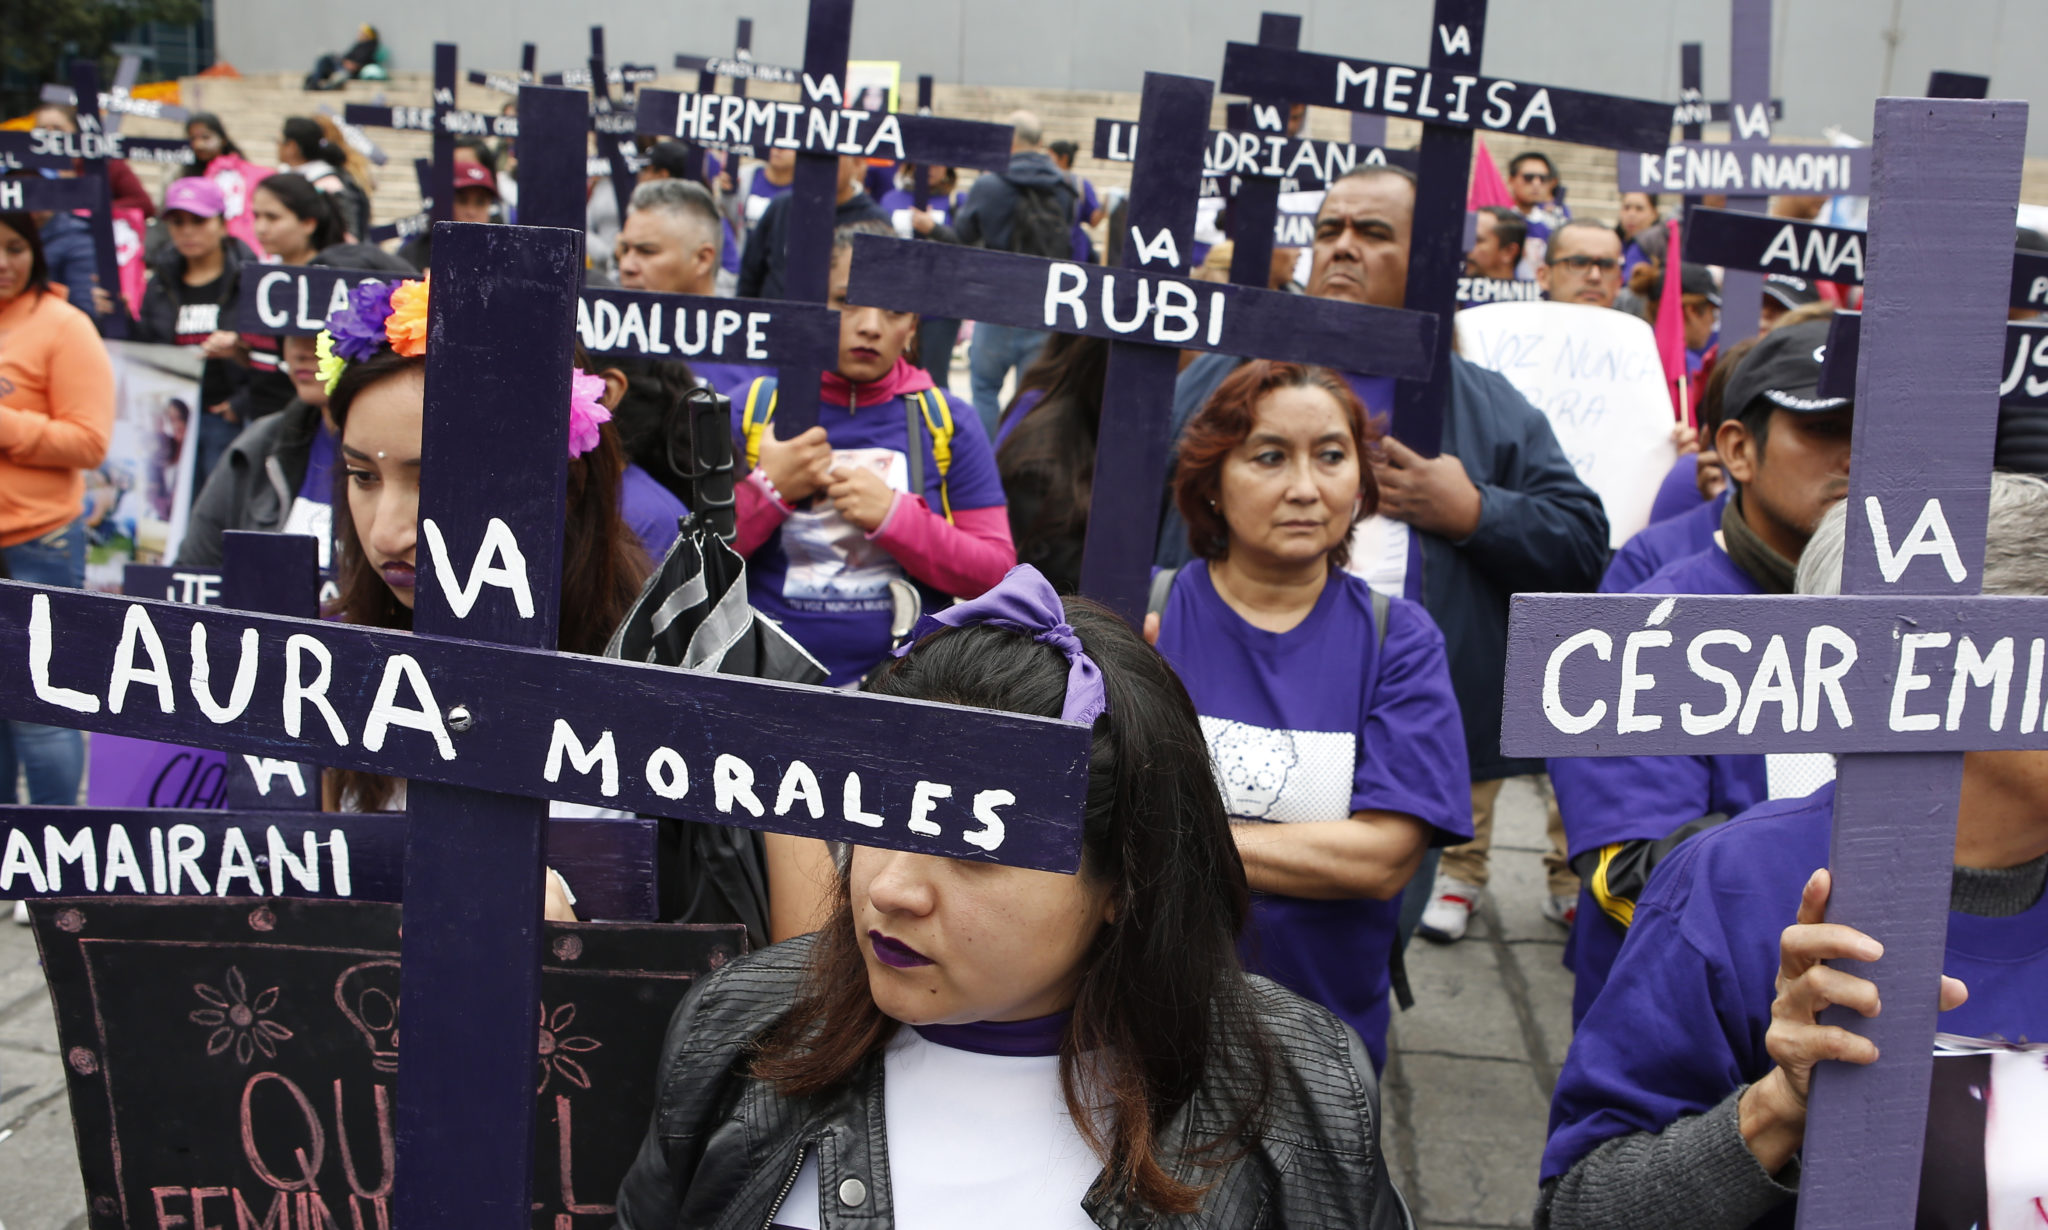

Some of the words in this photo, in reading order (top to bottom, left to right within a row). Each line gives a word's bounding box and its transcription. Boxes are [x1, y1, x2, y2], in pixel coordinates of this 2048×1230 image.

[1439, 23, 1471, 55] VA
[802, 72, 843, 105] VA
[1253, 104, 1282, 131] VA
[1336, 61, 1556, 134] MELISA
[1734, 103, 1770, 139] VA
[675, 92, 905, 159] HERMINIA
[1641, 146, 1744, 190] KENIA
[1751, 152, 1851, 190] NAOMI
[1131, 225, 1180, 268] VA
[1044, 262, 1226, 346] RUBI
[423, 518, 536, 619] VA
[1864, 495, 1968, 584] VA
[1542, 597, 1858, 736] CÉSAR
[1888, 631, 2048, 735] EMI
[28, 593, 456, 761] LAURA
[544, 718, 1016, 852] MORALES
[0, 823, 351, 897] AMAIRANI
